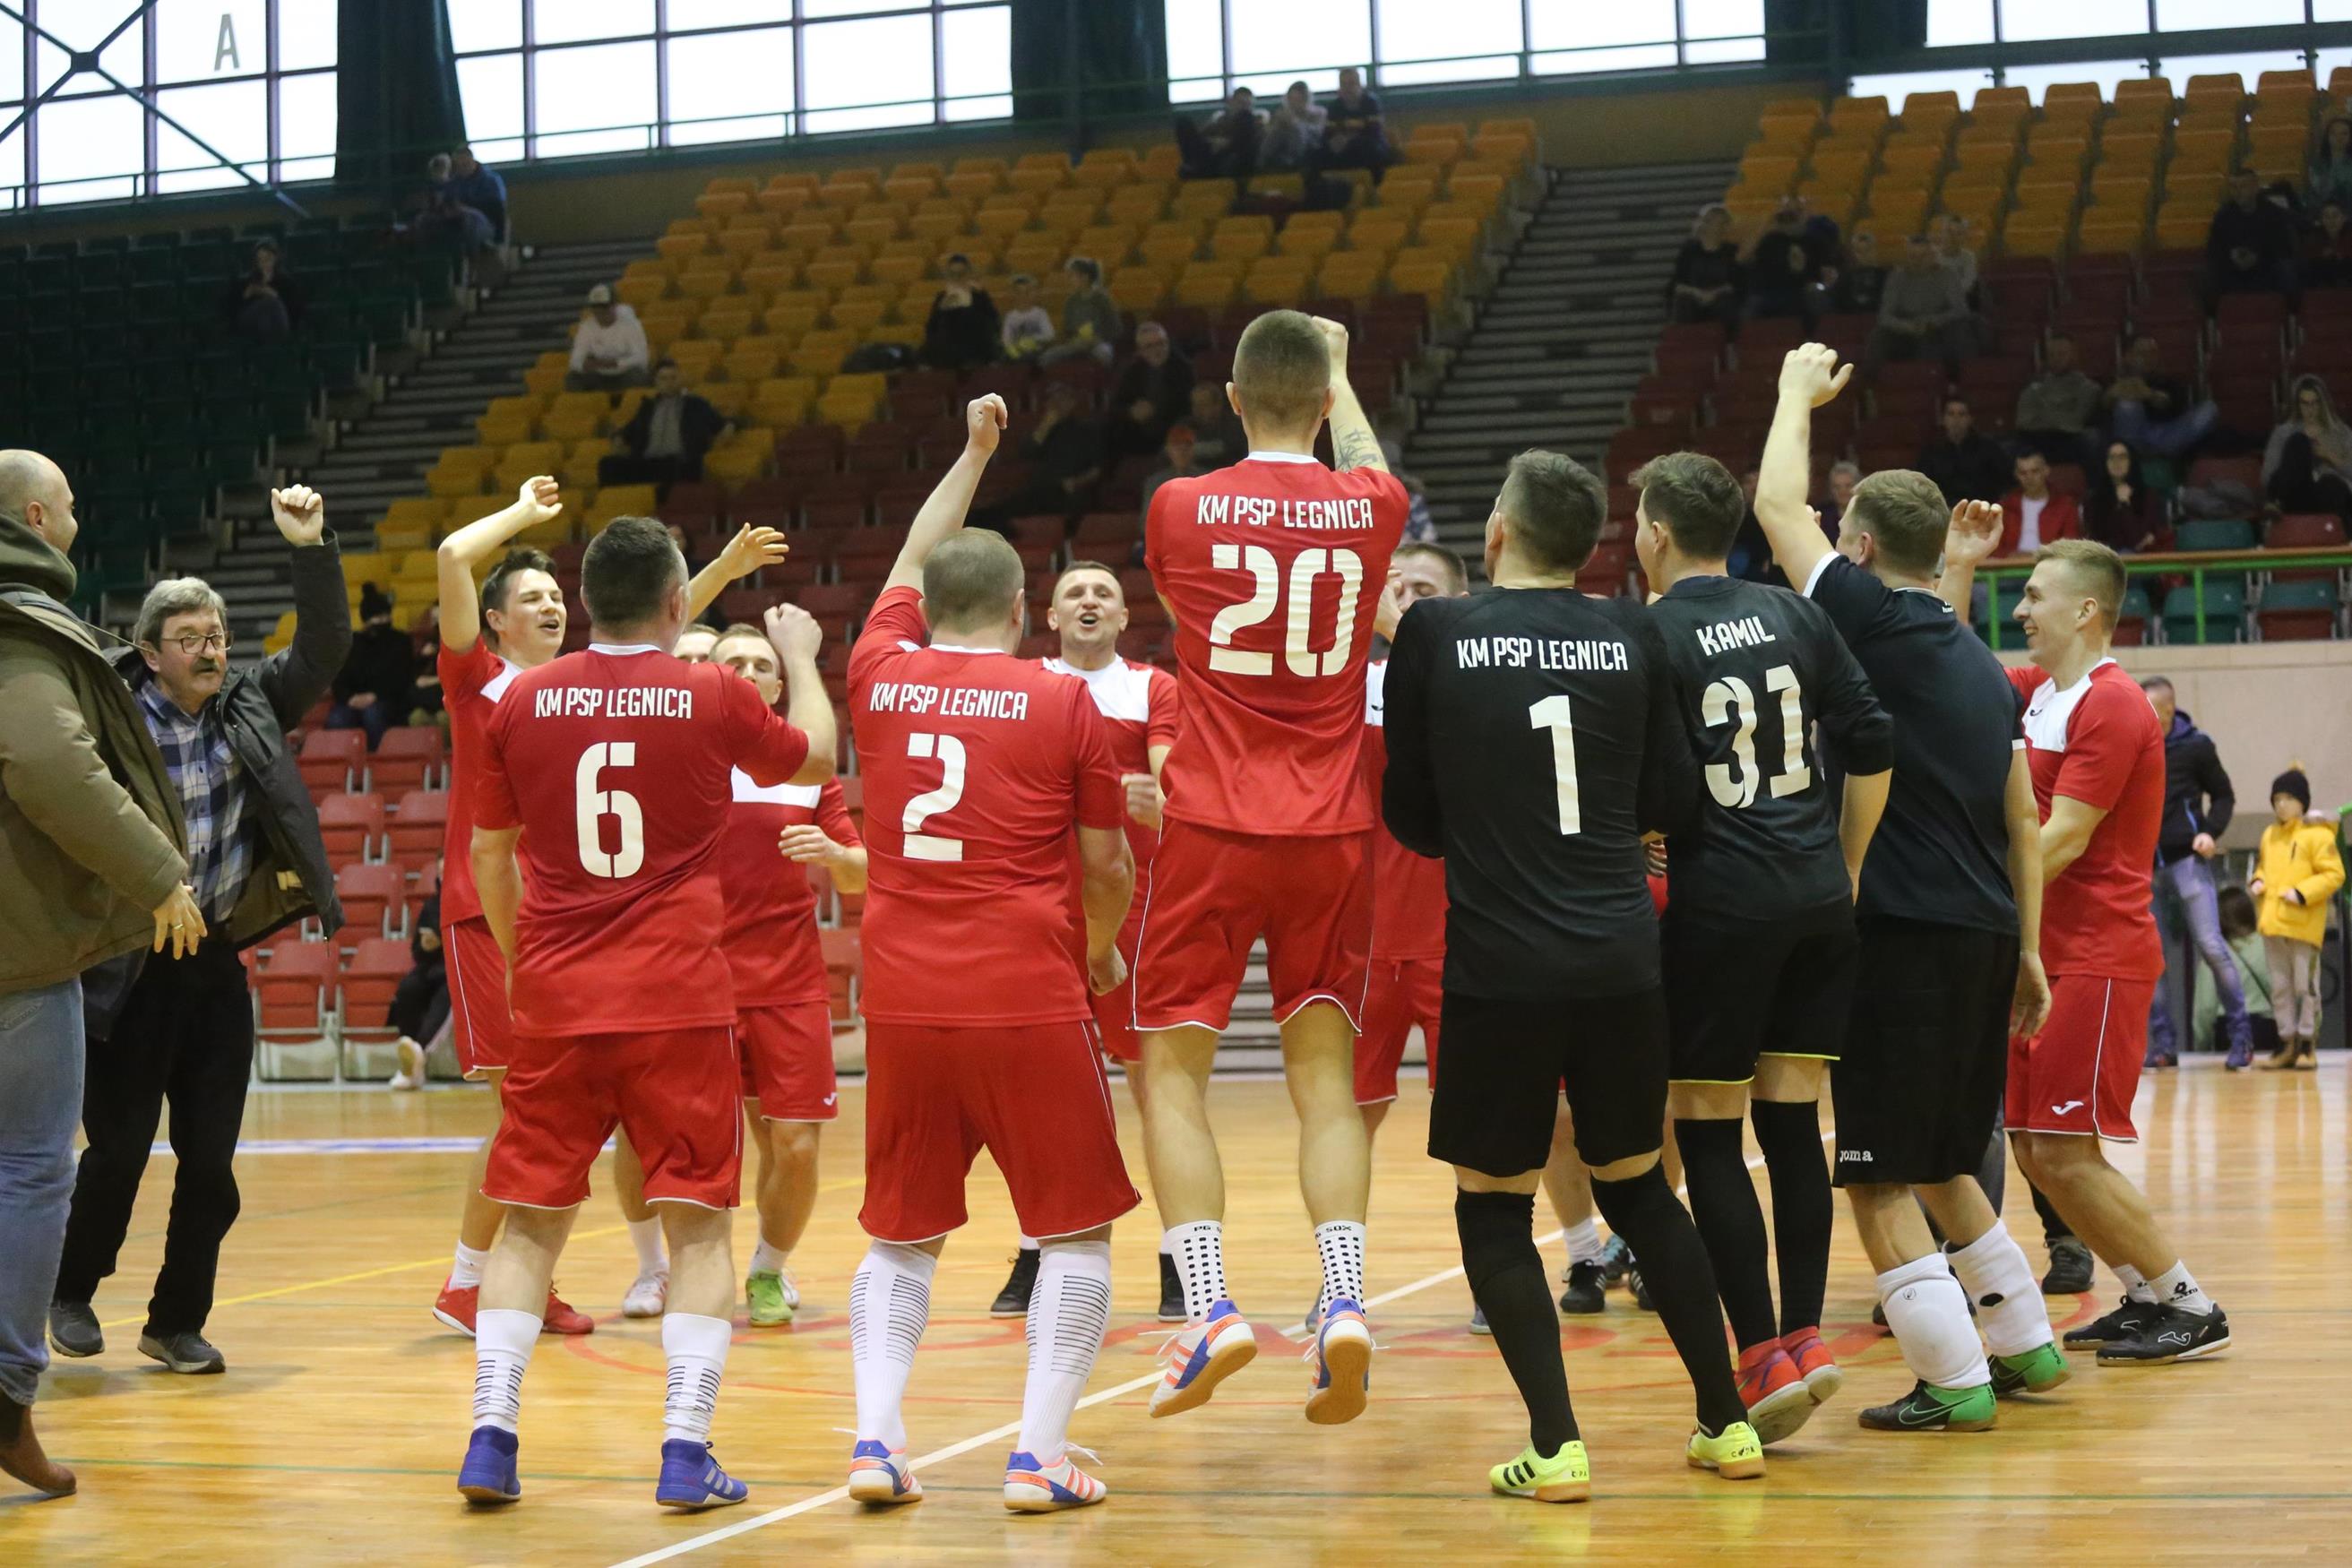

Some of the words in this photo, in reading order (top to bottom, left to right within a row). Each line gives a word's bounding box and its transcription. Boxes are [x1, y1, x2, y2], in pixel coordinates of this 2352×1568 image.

[214, 13, 240, 71] A
[1197, 495, 1230, 524] KM
[1233, 495, 1277, 527] PSP
[1281, 498, 1374, 530] LEGNICA
[1209, 544, 1365, 678] 20
[1695, 616, 1776, 657] KAMIL
[1456, 636, 1490, 669] KM
[1493, 636, 1532, 670] PSP
[1537, 639, 1629, 671] LEGNICA
[535, 687, 564, 718] KM
[564, 687, 603, 718] PSP
[606, 686, 693, 719] LEGNICA
[869, 682, 899, 711] KM
[898, 683, 939, 715] PSP
[939, 687, 1029, 720] LEGNICA
[1529, 694, 1581, 835] 1
[1702, 664, 1811, 808] 31
[575, 742, 644, 878] 6
[901, 732, 967, 862] 2
